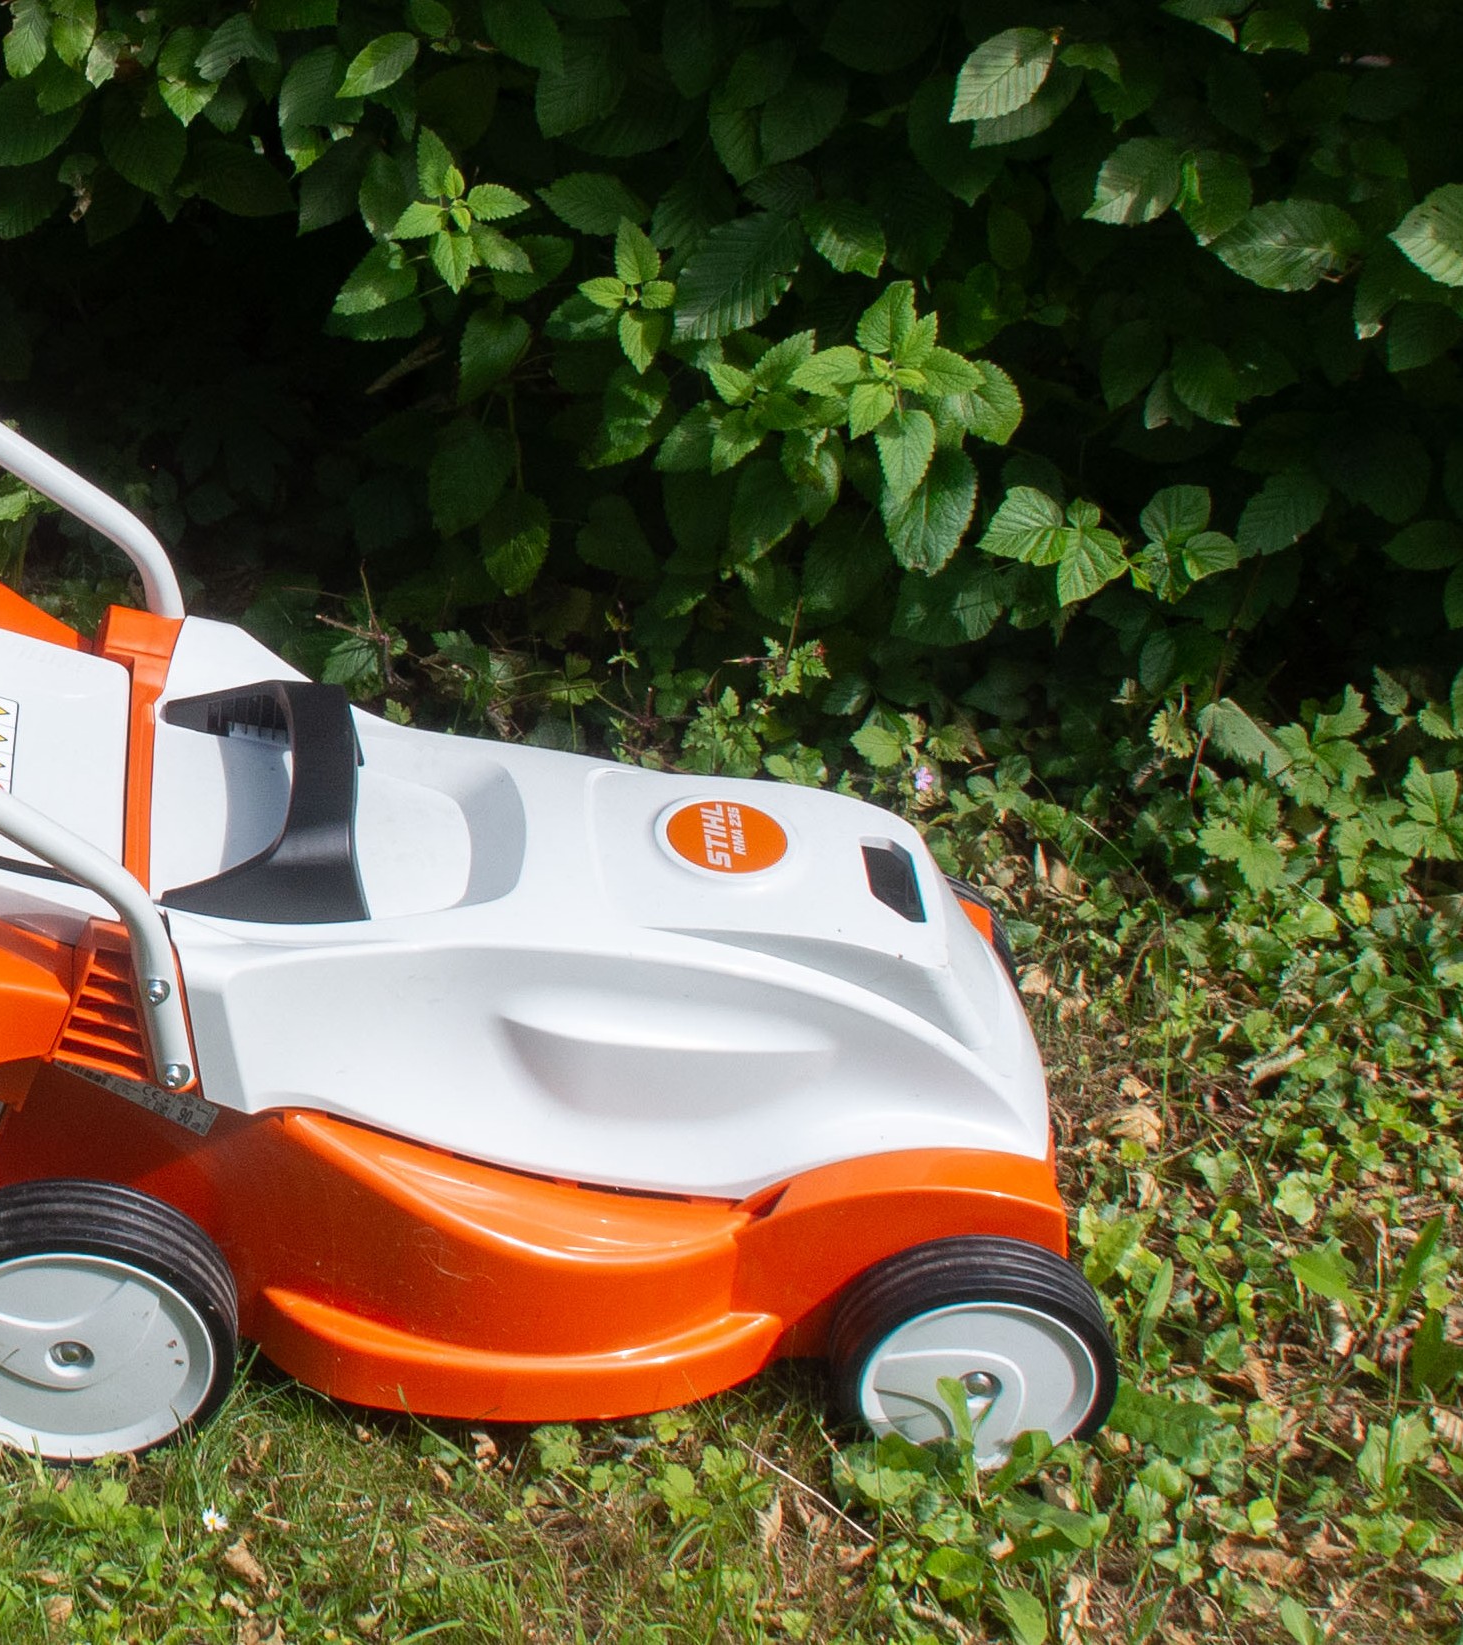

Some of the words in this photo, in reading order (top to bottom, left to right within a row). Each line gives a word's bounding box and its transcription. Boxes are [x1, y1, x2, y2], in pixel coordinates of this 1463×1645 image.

[727, 806, 743, 828] 235
[700, 803, 732, 868] STIHL
[730, 829, 747, 856] RMA
